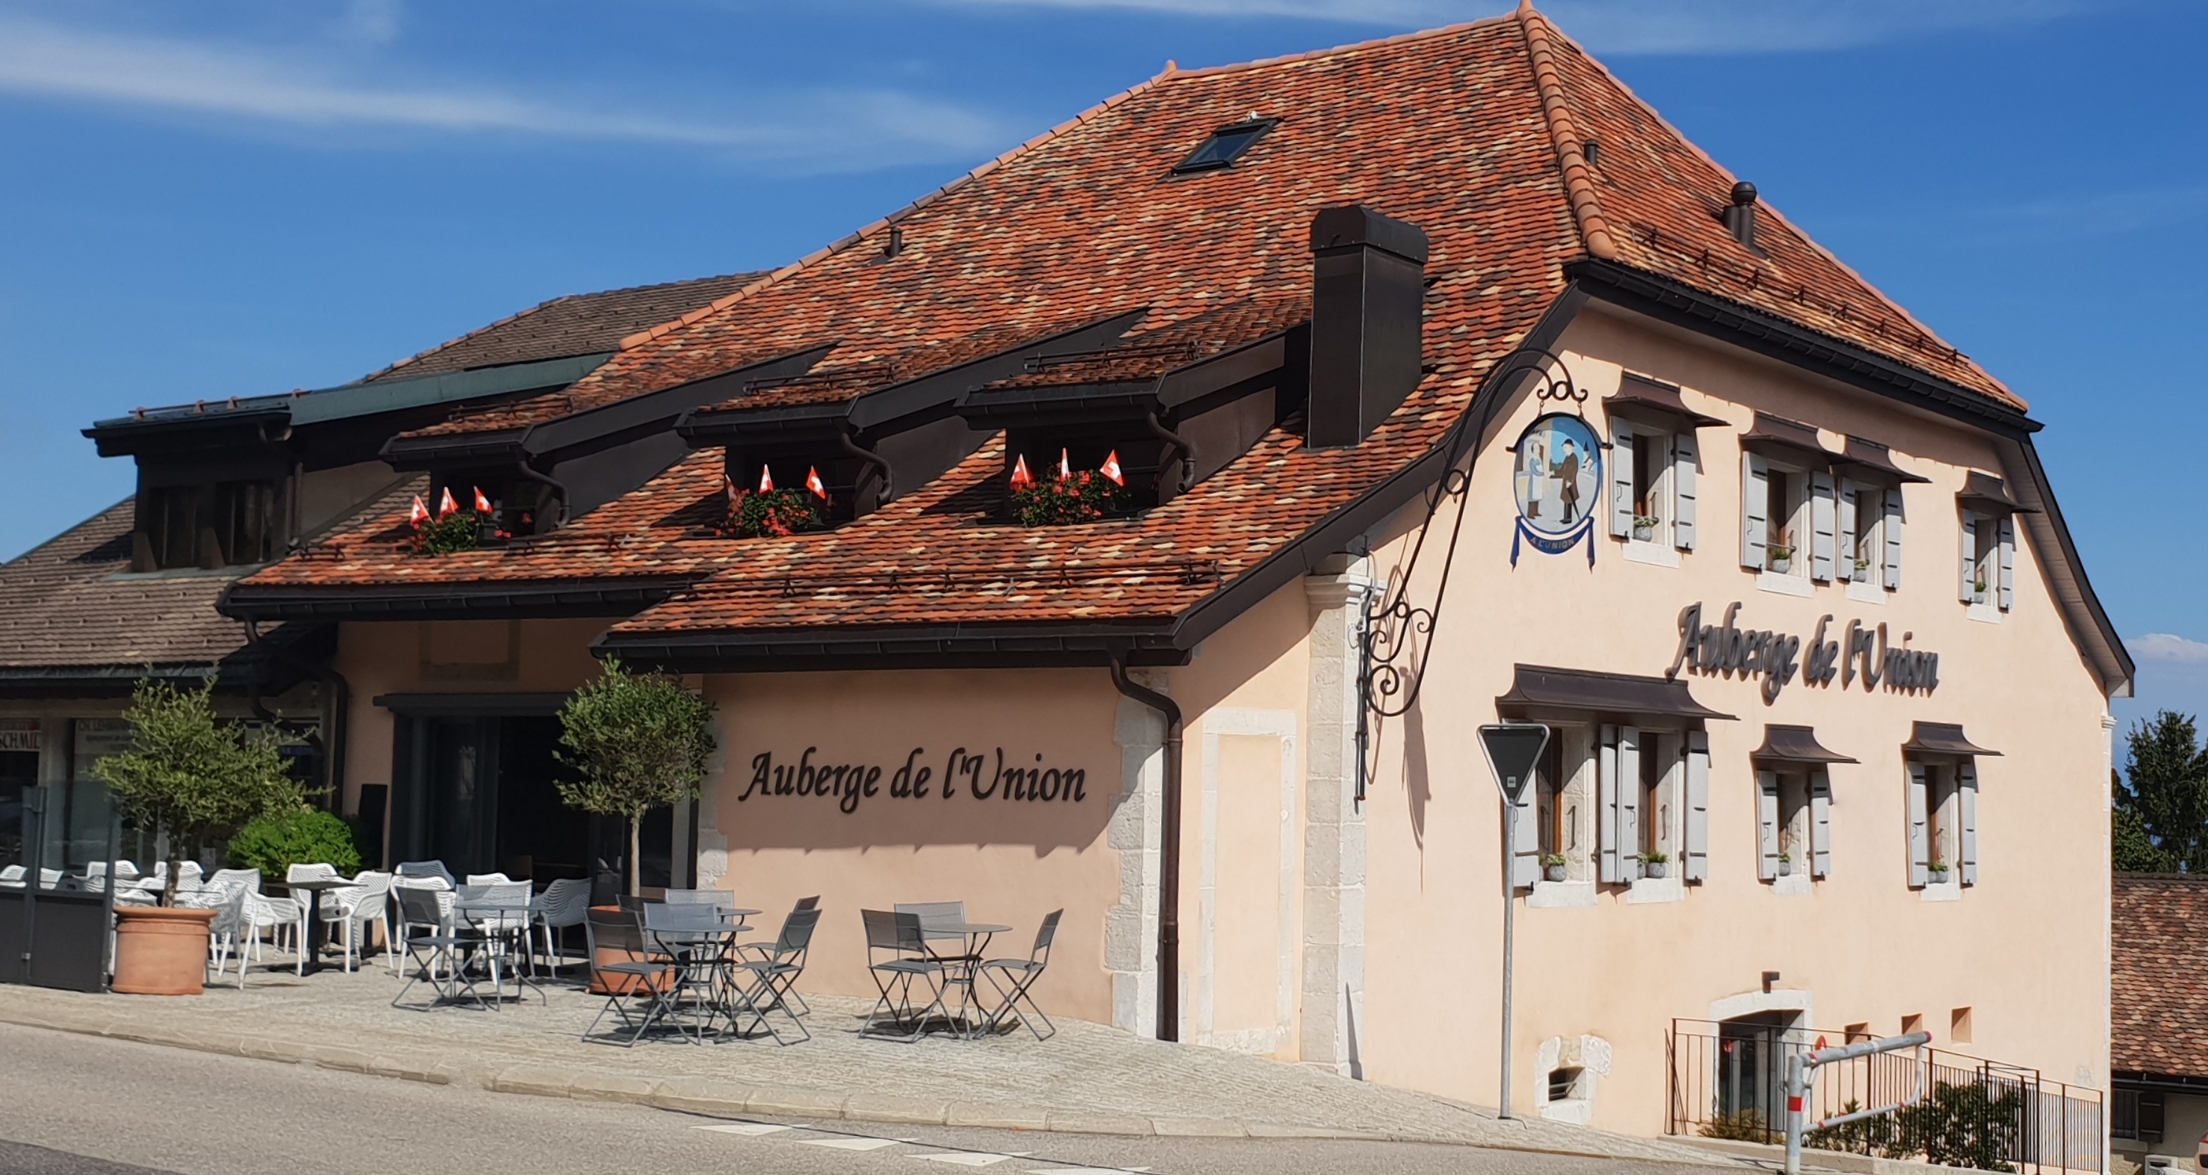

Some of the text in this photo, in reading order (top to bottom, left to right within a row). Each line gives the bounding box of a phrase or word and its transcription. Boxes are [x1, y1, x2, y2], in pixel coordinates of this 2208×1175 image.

[1664, 601, 1939, 706] Auberge de l'Union
[738, 746, 1087, 814] Auberge de l'Union
